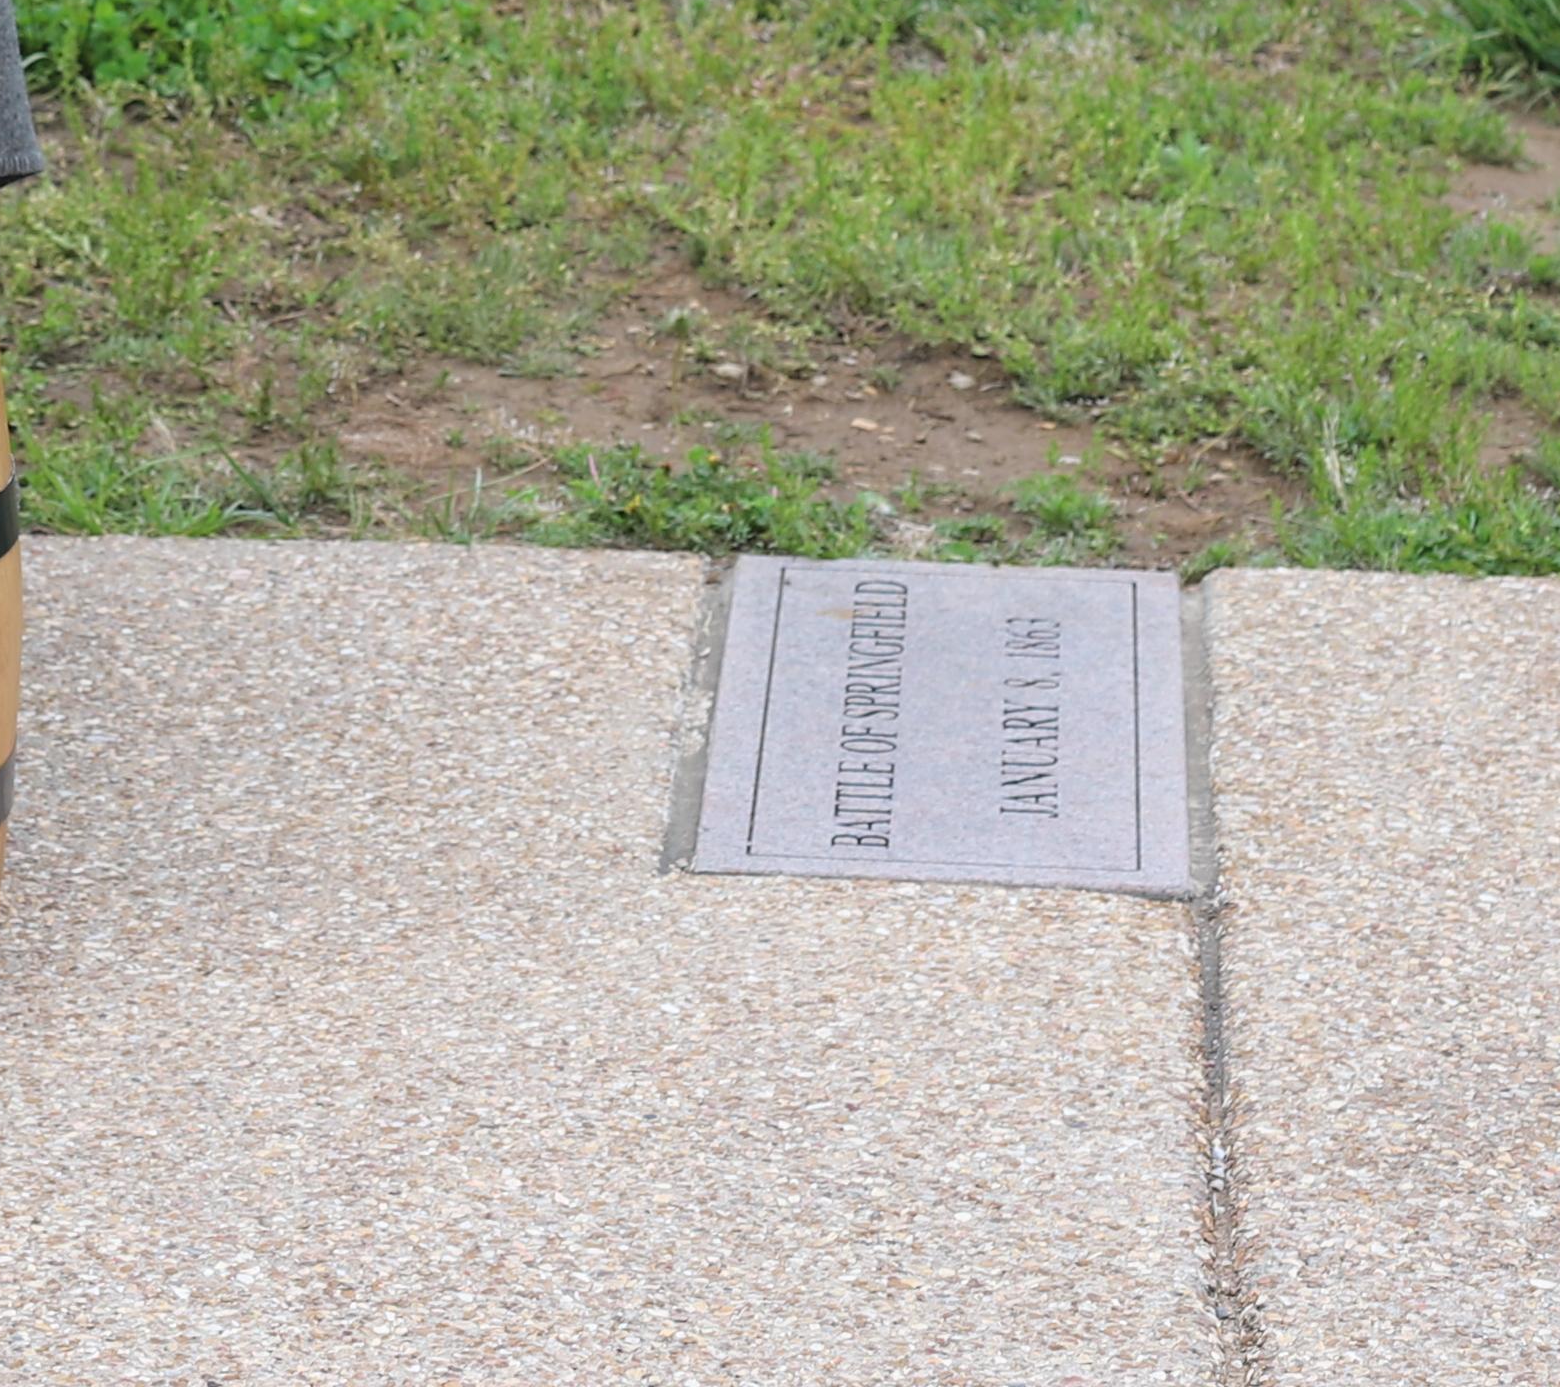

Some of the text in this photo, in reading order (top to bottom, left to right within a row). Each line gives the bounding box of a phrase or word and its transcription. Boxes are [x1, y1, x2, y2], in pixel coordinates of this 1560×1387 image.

[1005, 616, 1060, 659] 1863
[831, 580, 908, 848] BATTLE OF SPRINGFIELD
[999, 698, 1060, 819] JANUARY
